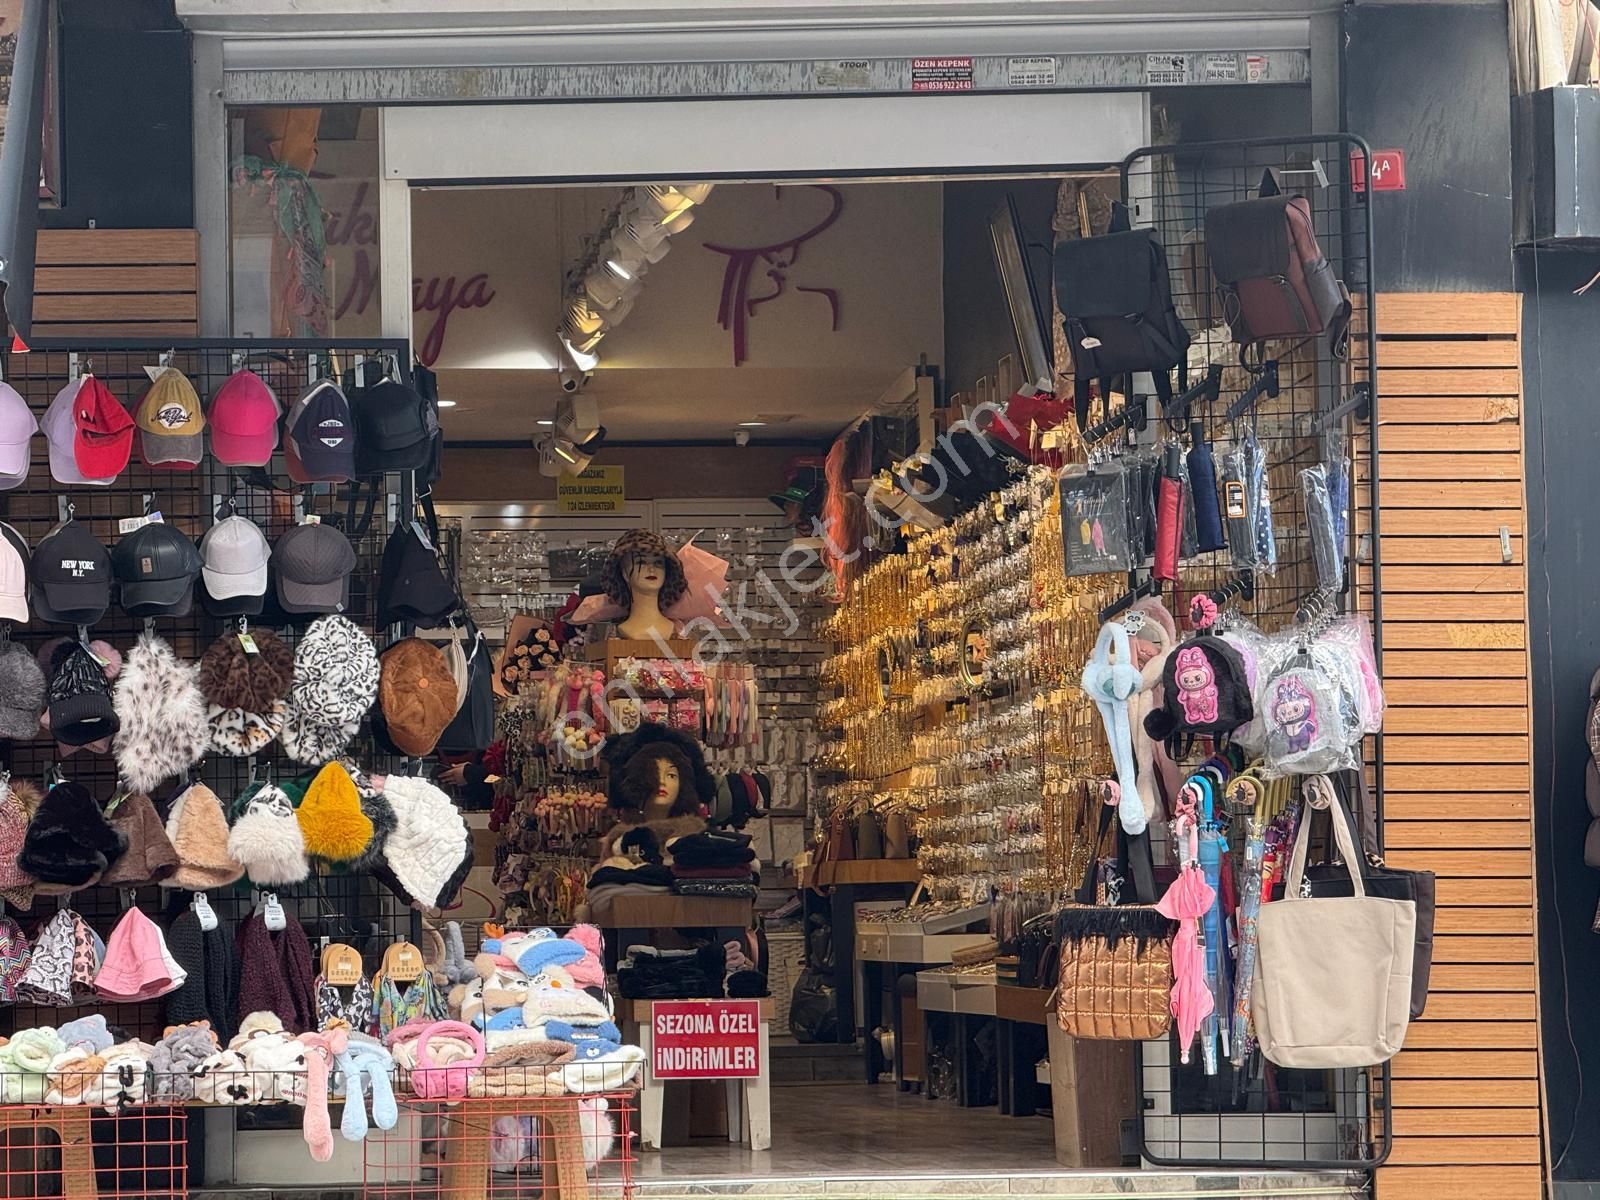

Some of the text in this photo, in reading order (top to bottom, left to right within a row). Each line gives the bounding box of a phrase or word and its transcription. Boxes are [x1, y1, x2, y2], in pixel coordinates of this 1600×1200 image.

[914, 59, 970, 68] ÖZEN KEPENK
[928, 81, 944, 89] 0536
[943, 81, 955, 89] 922
[61, 559, 95, 570] NEW YORK
[656, 1009, 756, 1035] SEZONA ÖZEL
